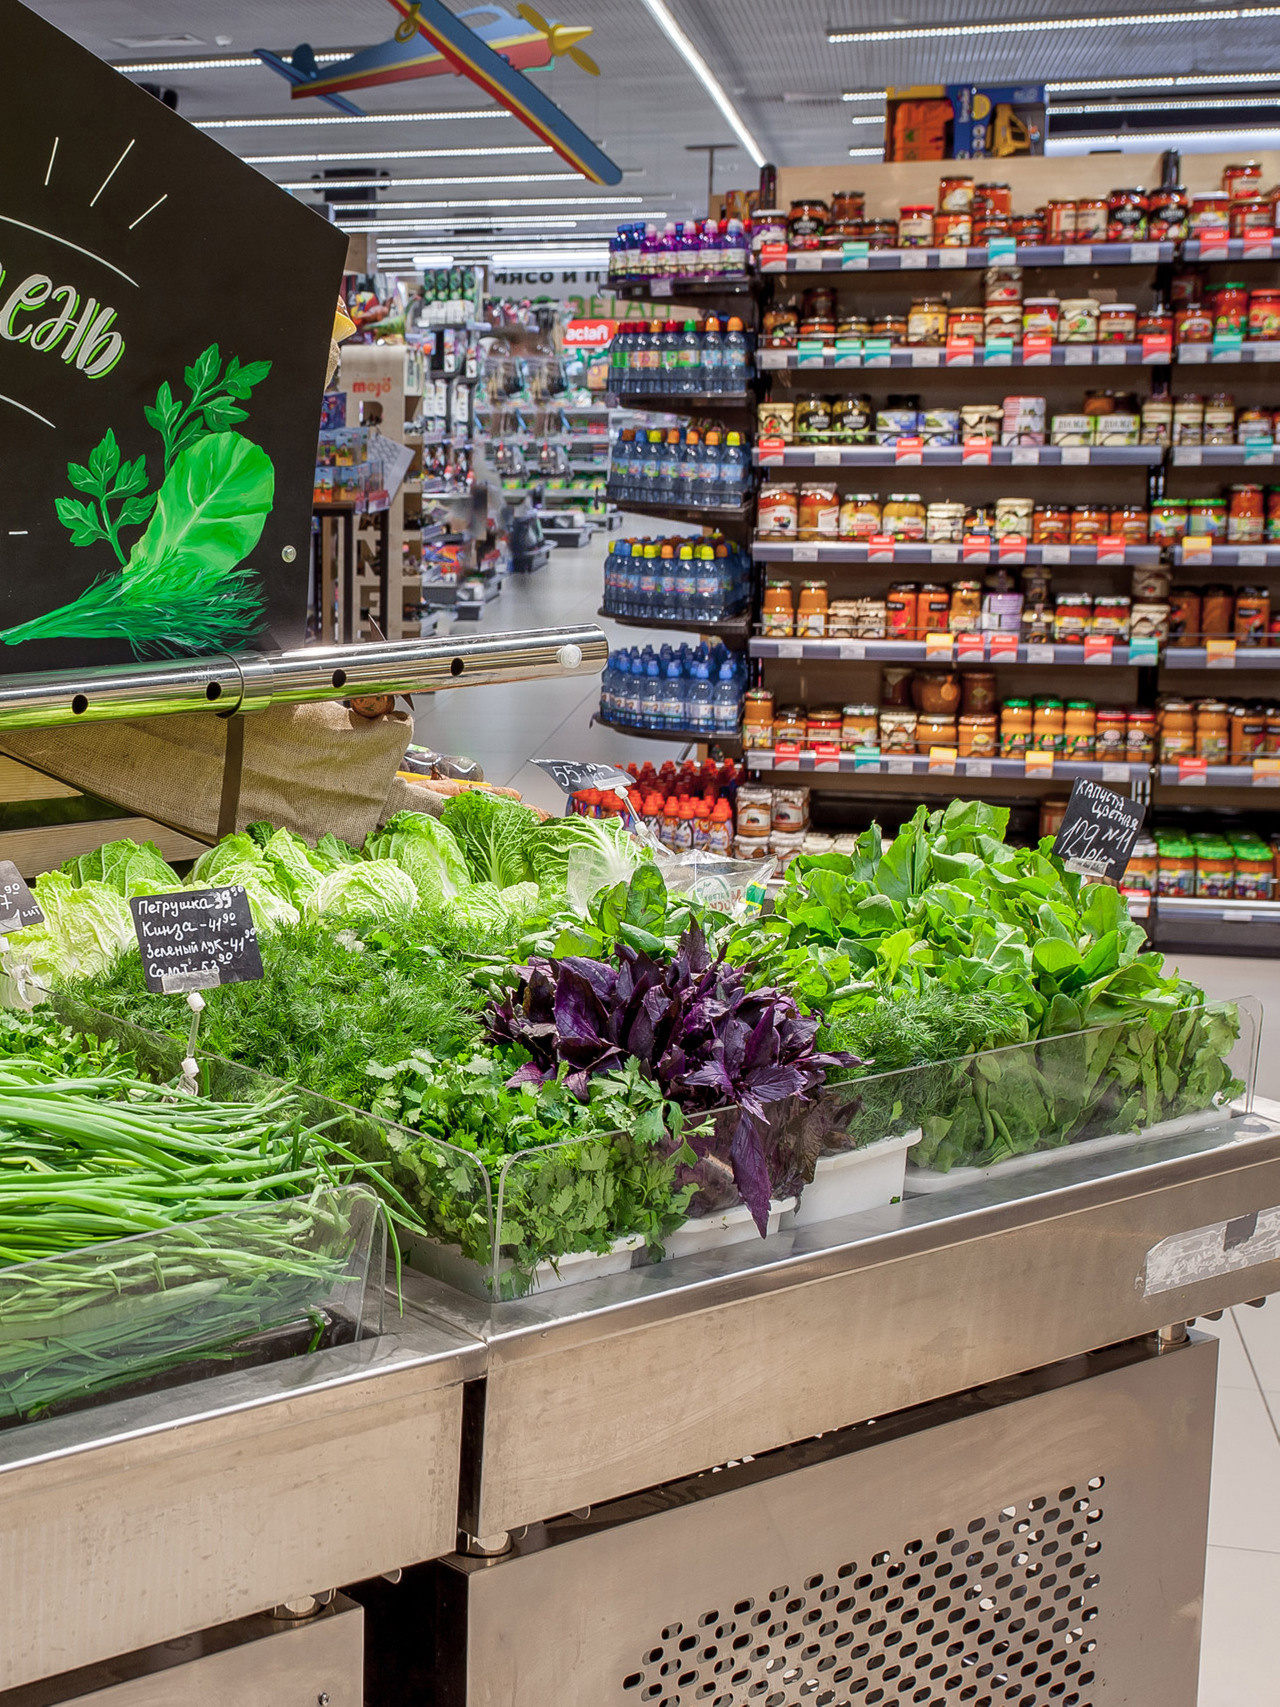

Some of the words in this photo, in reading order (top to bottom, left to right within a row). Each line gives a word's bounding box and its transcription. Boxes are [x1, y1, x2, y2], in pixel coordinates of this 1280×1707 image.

[1075, 779, 1125, 811] КАПУСТА
[1091, 800, 1139, 831] ЦВЕТНАЯ
[138, 898, 214, 917] Петрушка
[142, 921, 198, 940] Кинза
[147, 941, 199, 959] Зеленый
